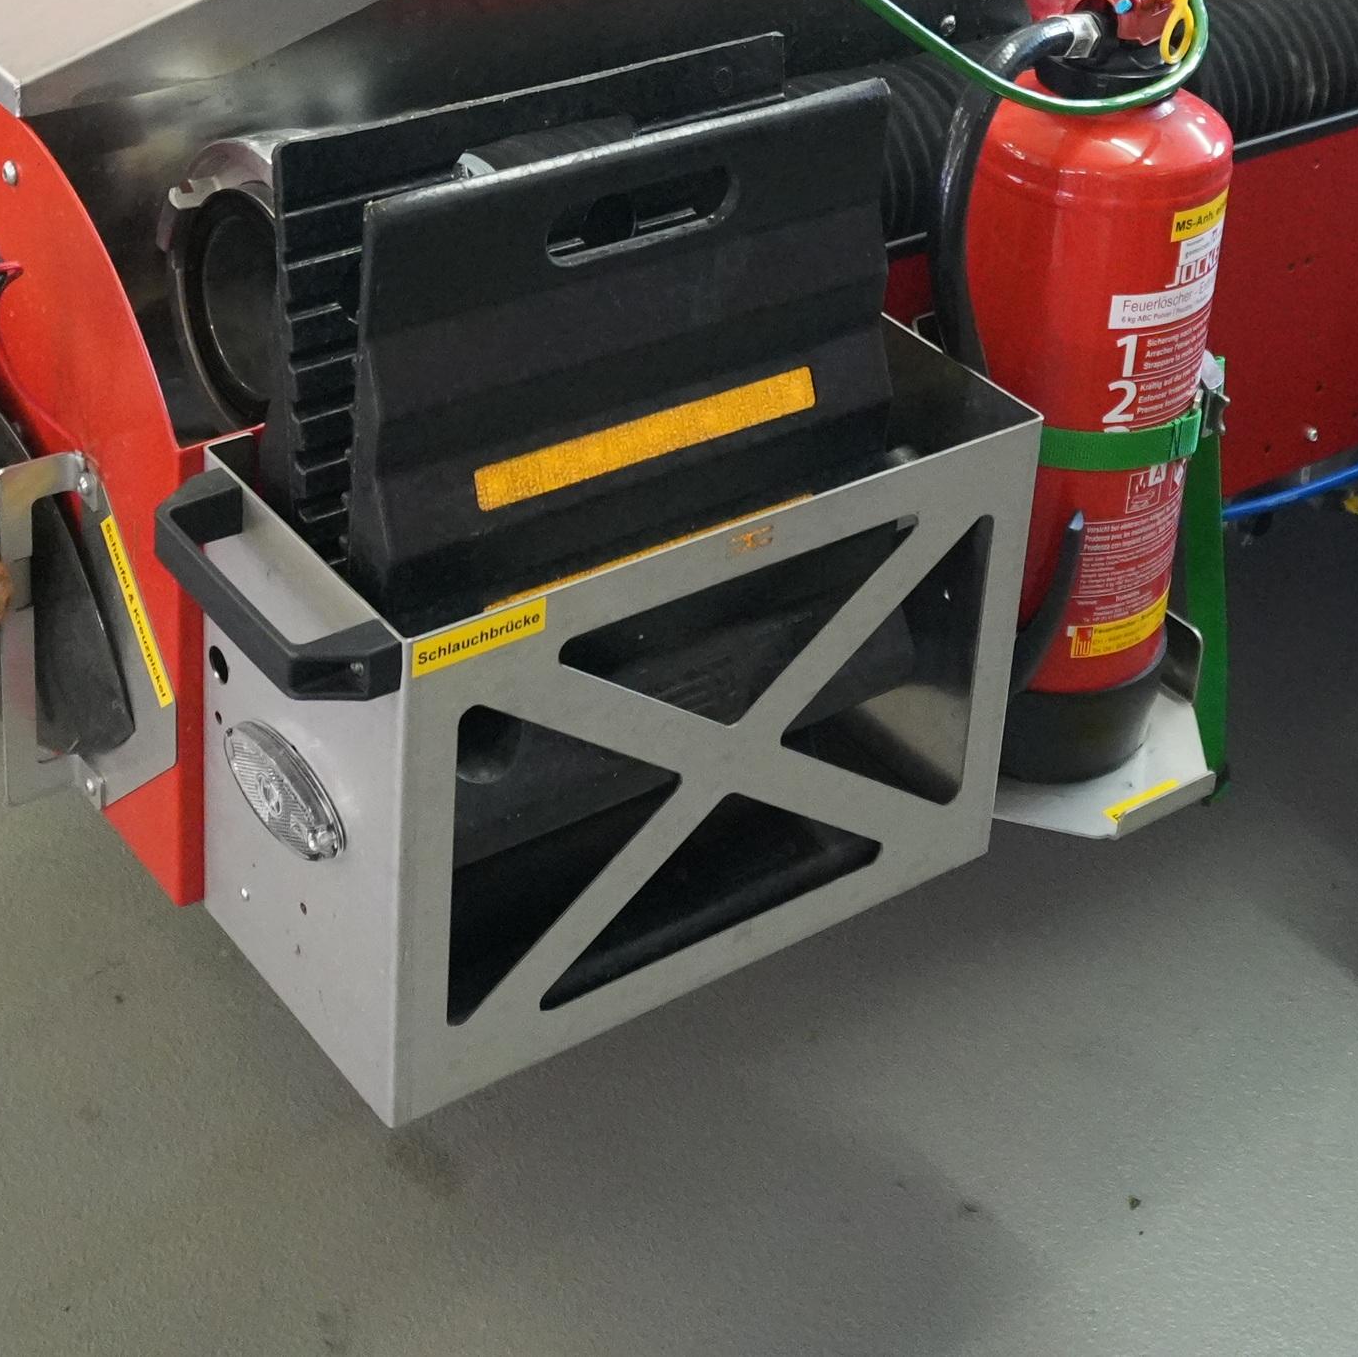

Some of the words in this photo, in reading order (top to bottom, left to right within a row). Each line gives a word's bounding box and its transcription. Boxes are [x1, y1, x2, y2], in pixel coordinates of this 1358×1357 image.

[1122, 290, 1193, 313] Feuerlöscher
[1116, 334, 1138, 378] 1
[1102, 380, 1137, 424] 2
[105, 522, 131, 590] Schaufel
[133, 608, 167, 698] Kreuzpickel
[417, 612, 541, 666] Schlauchbrücke
